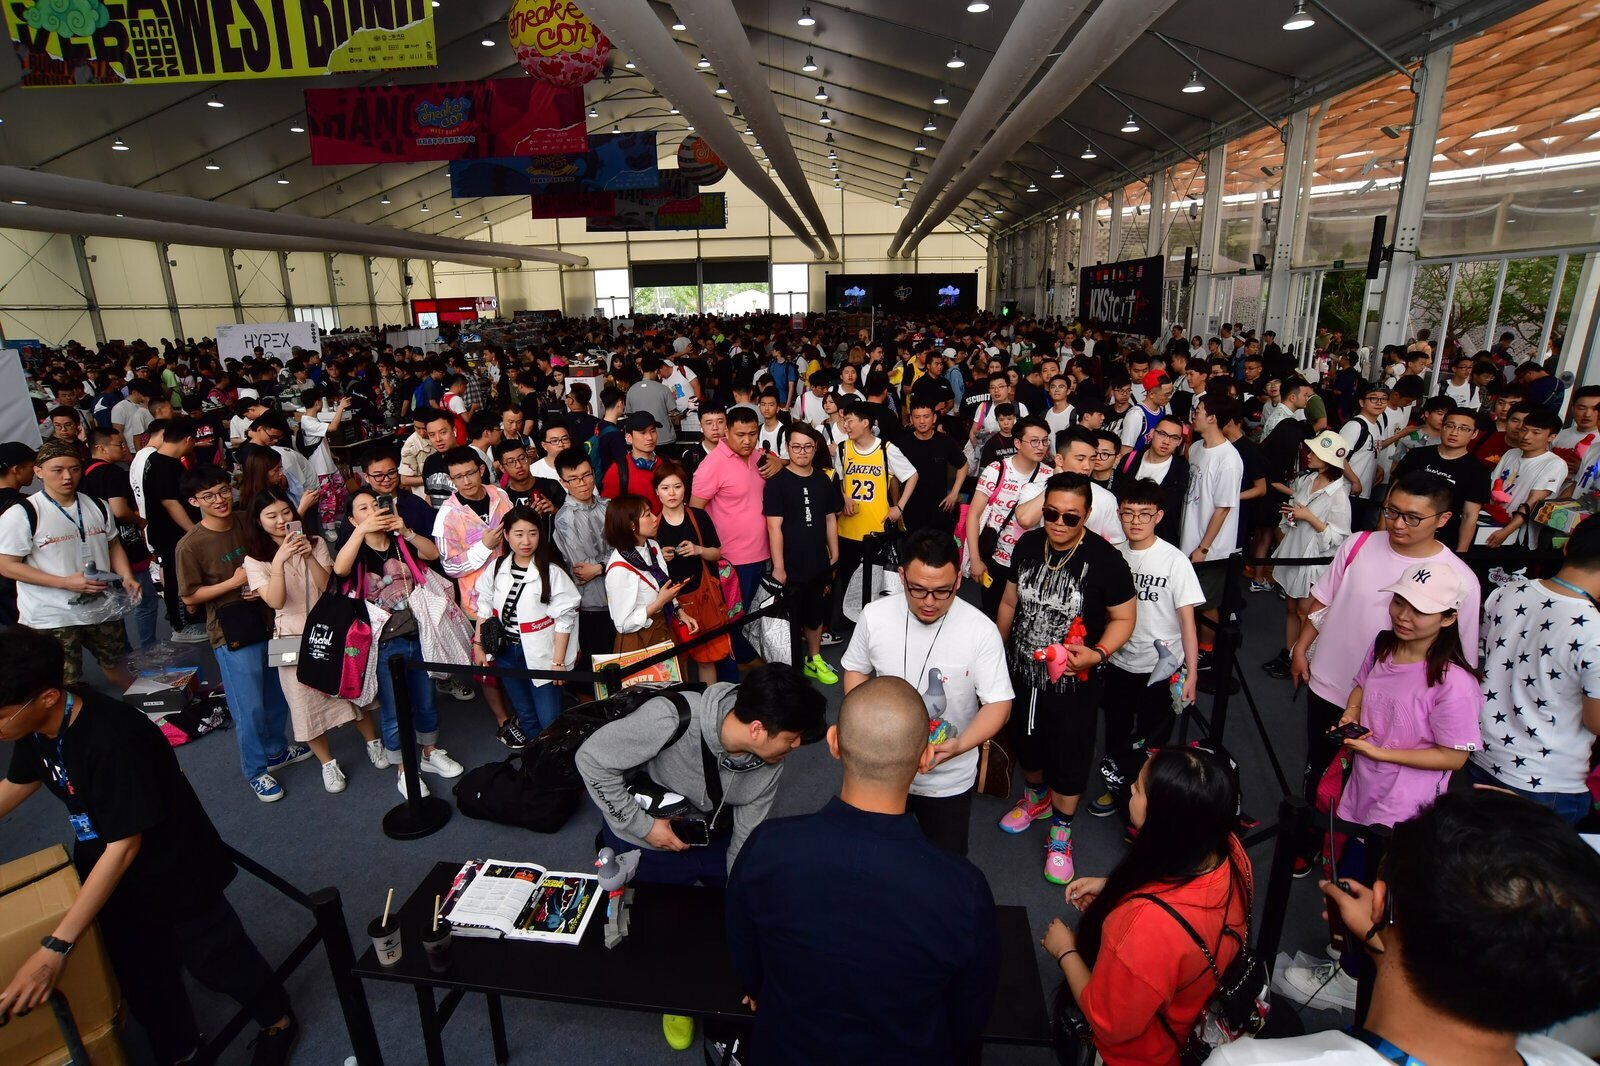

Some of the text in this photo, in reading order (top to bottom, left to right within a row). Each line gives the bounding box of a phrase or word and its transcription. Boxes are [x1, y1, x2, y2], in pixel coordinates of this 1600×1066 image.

[168, 0, 293, 74] WEST
[244, 333, 291, 348] HYPEX
[965, 393, 991, 405] SECURIT
[846, 461, 882, 477] LAKERS
[851, 479, 875, 501] 23
[387, 951, 396, 960] R
